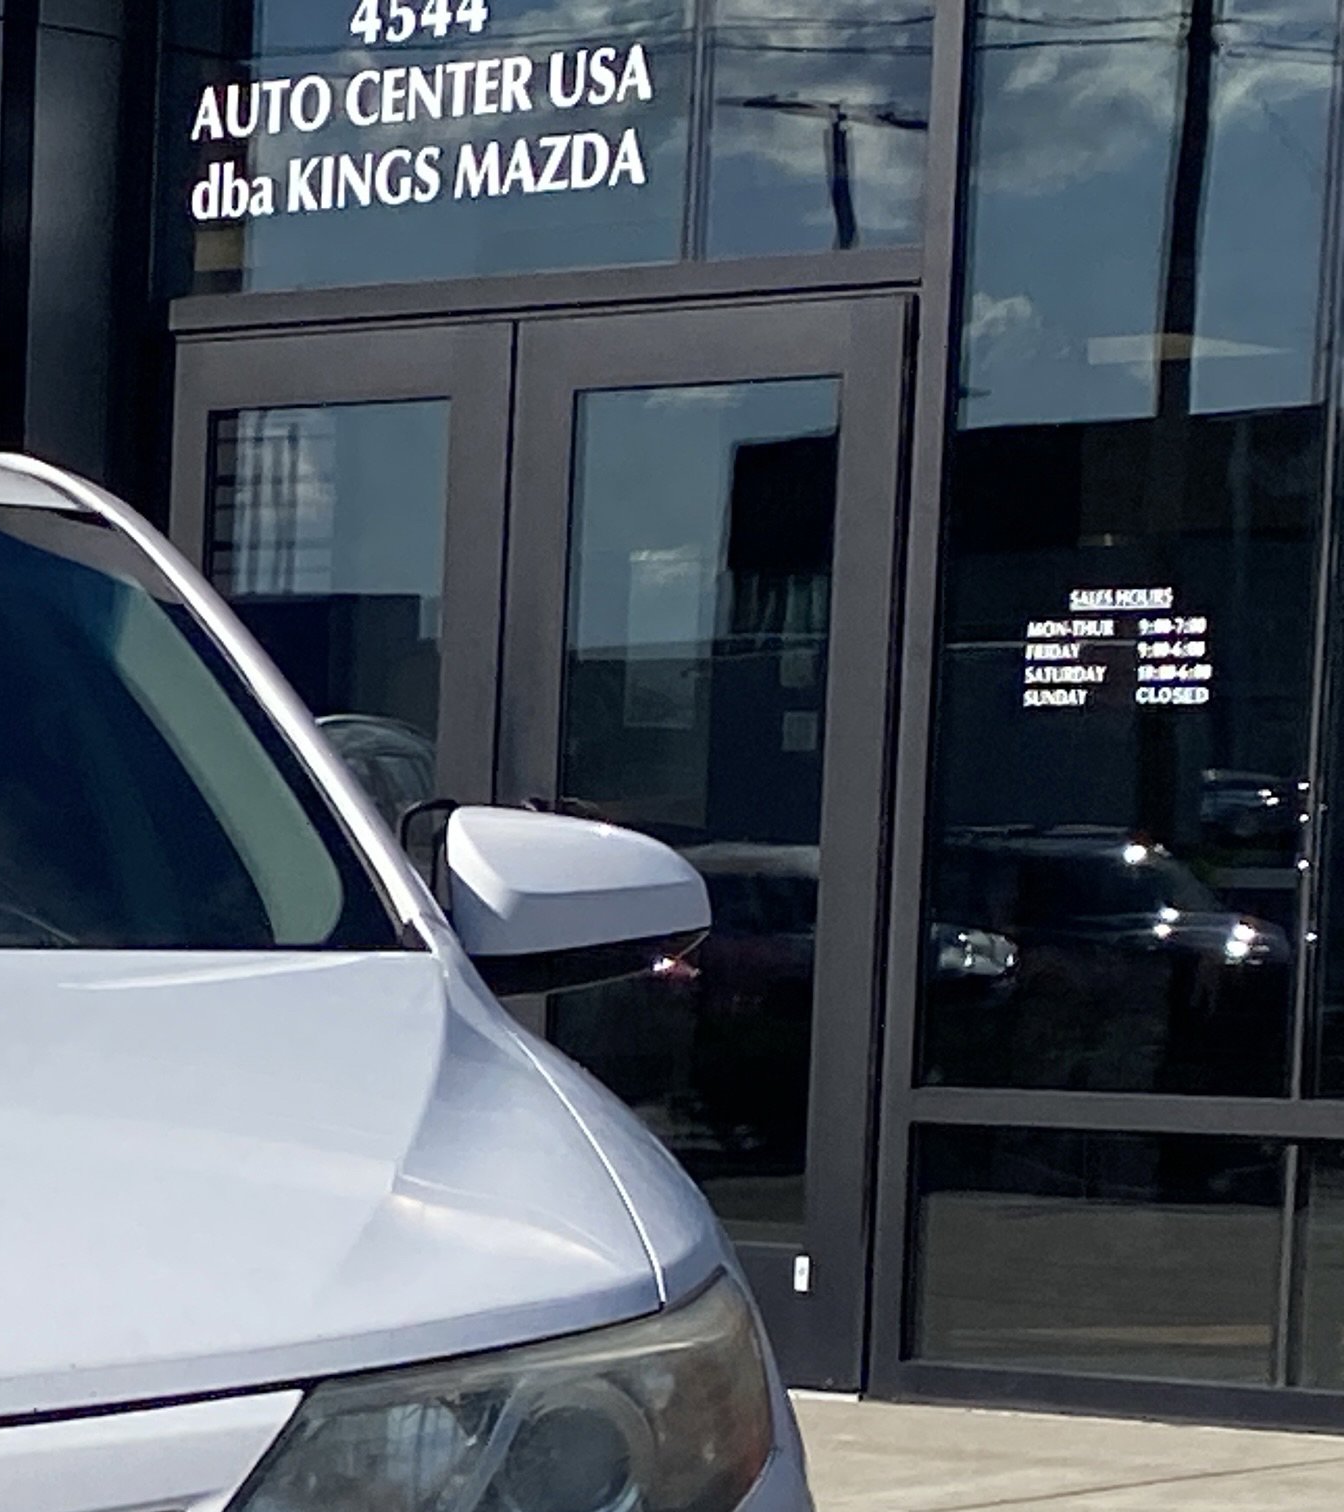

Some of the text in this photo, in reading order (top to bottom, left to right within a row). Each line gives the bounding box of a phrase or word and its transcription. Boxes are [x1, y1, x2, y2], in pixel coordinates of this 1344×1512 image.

[350, 0, 489, 43] 4544
[191, 43, 653, 140] AUTO CENTER USA
[191, 128, 647, 220] dba KINGS MAZDA
[1069, 586, 1173, 611] SALES HOURS
[1027, 619, 1114, 638] MON-THUR
[1025, 643, 1080, 660] FRIDAY
[1024, 666, 1107, 684] SATURDAY
[1023, 687, 1210, 707] SUNDAY CLOSED
